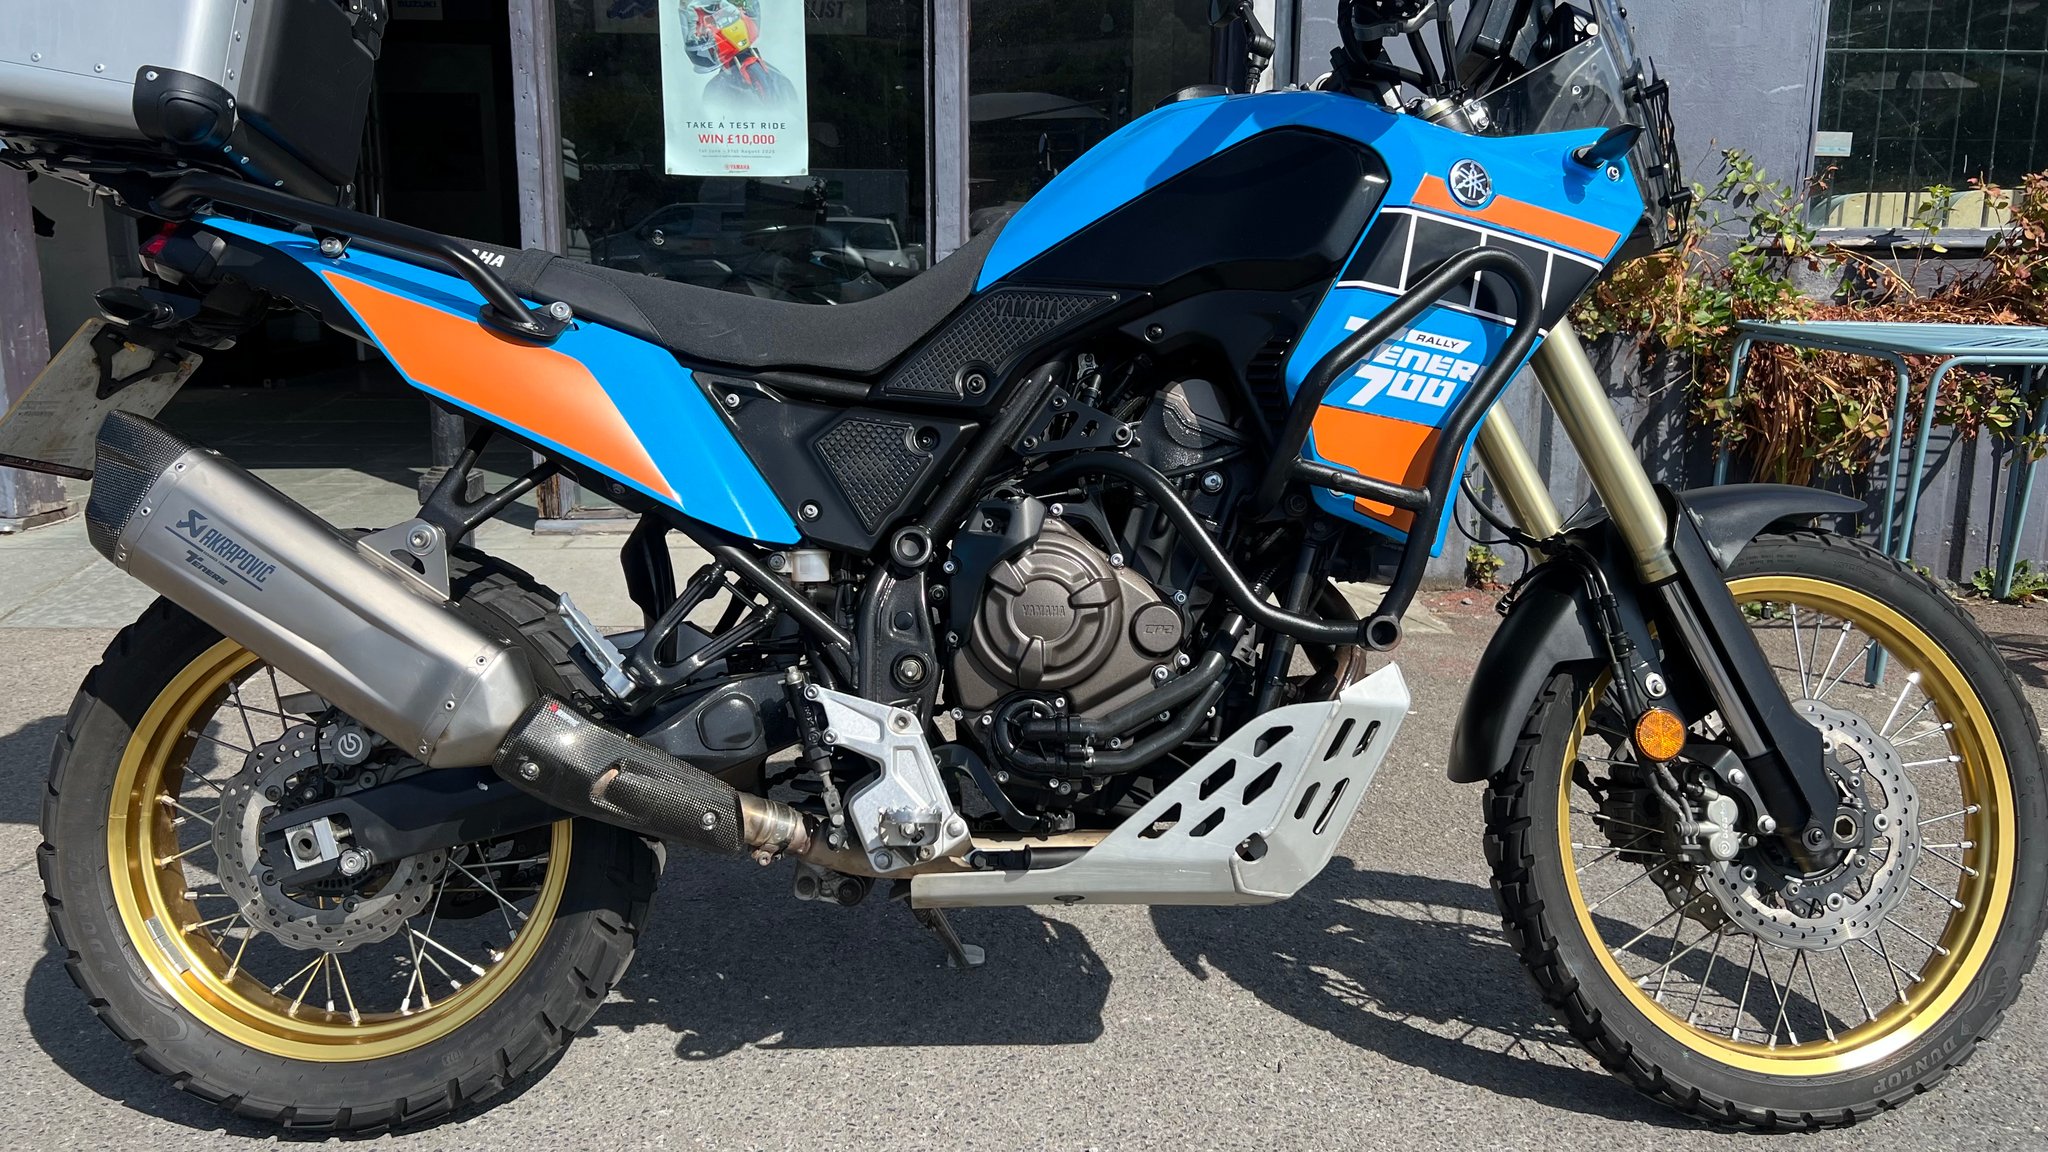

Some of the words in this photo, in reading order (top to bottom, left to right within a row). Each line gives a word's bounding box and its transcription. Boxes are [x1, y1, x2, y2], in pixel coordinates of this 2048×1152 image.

[686, 121, 714, 129] TAKE
[718, 121, 725, 129] A
[760, 122, 786, 130] RIDE
[698, 134, 724, 144] WIN
[727, 134, 775, 146] £10,000
[995, 300, 1059, 320] YAMAHA
[1415, 334, 1460, 349] RALLY
[1347, 364, 1457, 408] 700
[1022, 604, 1066, 617] YAMAHA
[1873, 1035, 1957, 1094] DUNLOP
